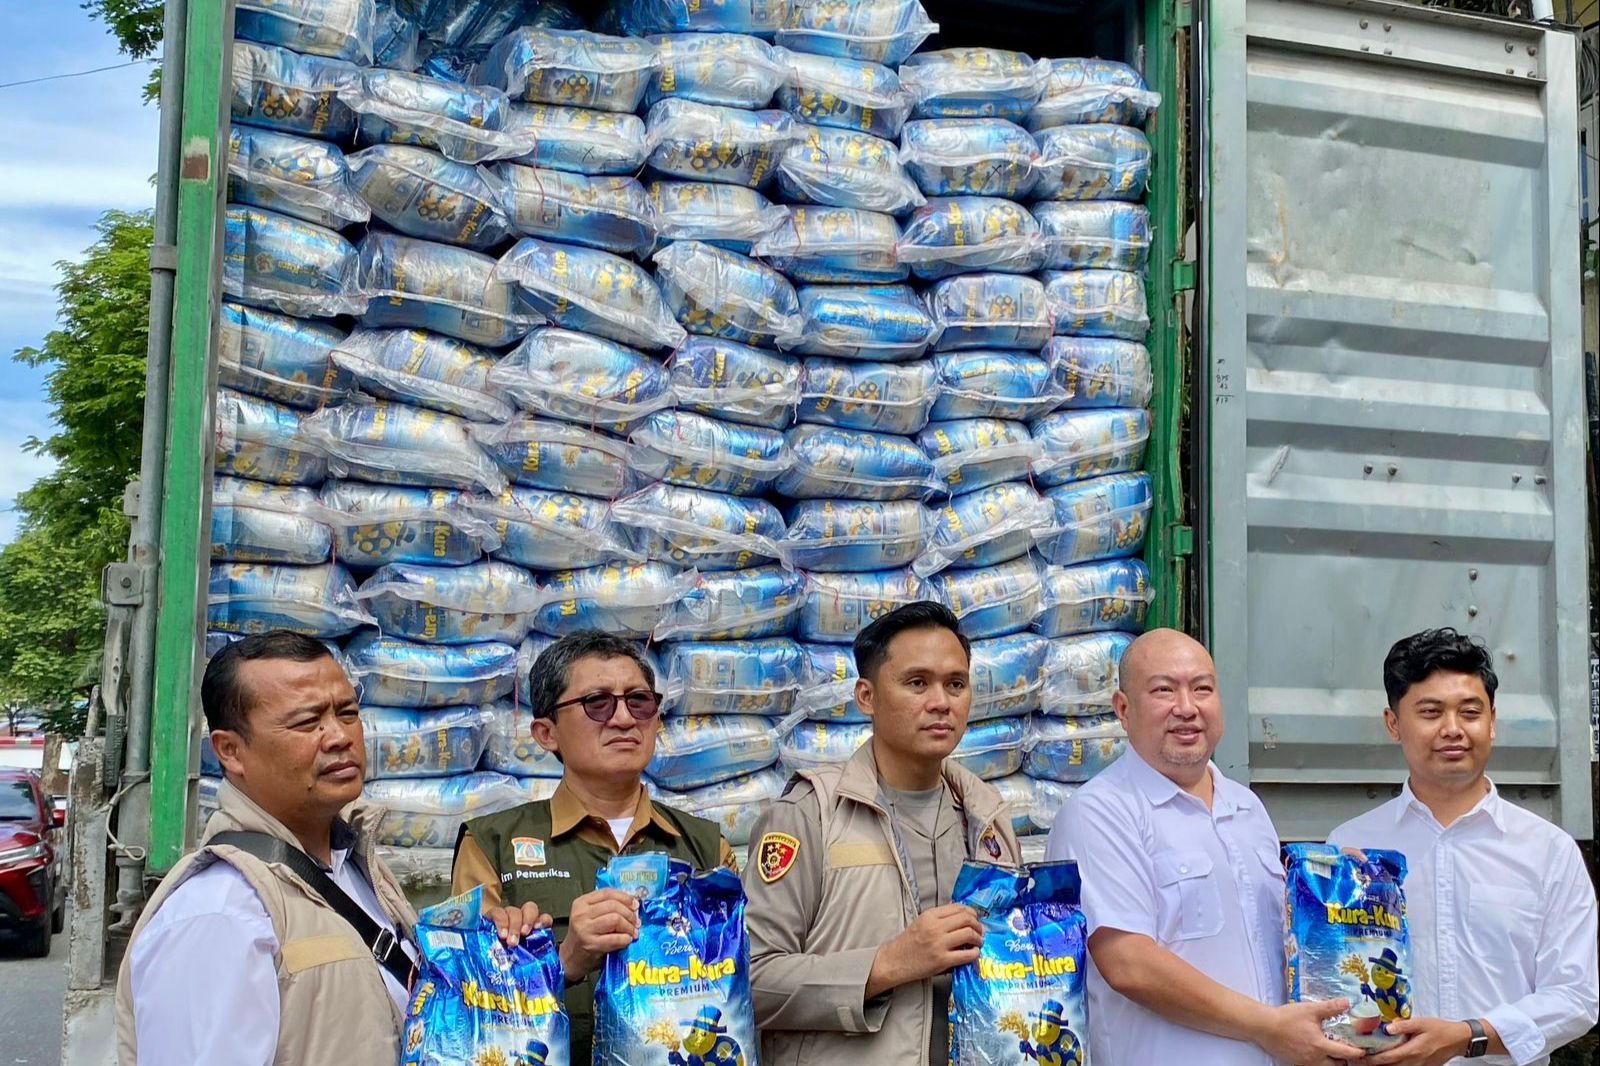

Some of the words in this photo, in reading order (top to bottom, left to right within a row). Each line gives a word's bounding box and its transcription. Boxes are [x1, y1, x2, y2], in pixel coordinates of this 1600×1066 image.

[501, 872, 514, 884] im
[515, 867, 571, 879] Pemeriksa
[627, 954, 737, 987] Kura-Kura
[978, 952, 1078, 981] Kura-Kura
[659, 983, 711, 997] PREMIUM
